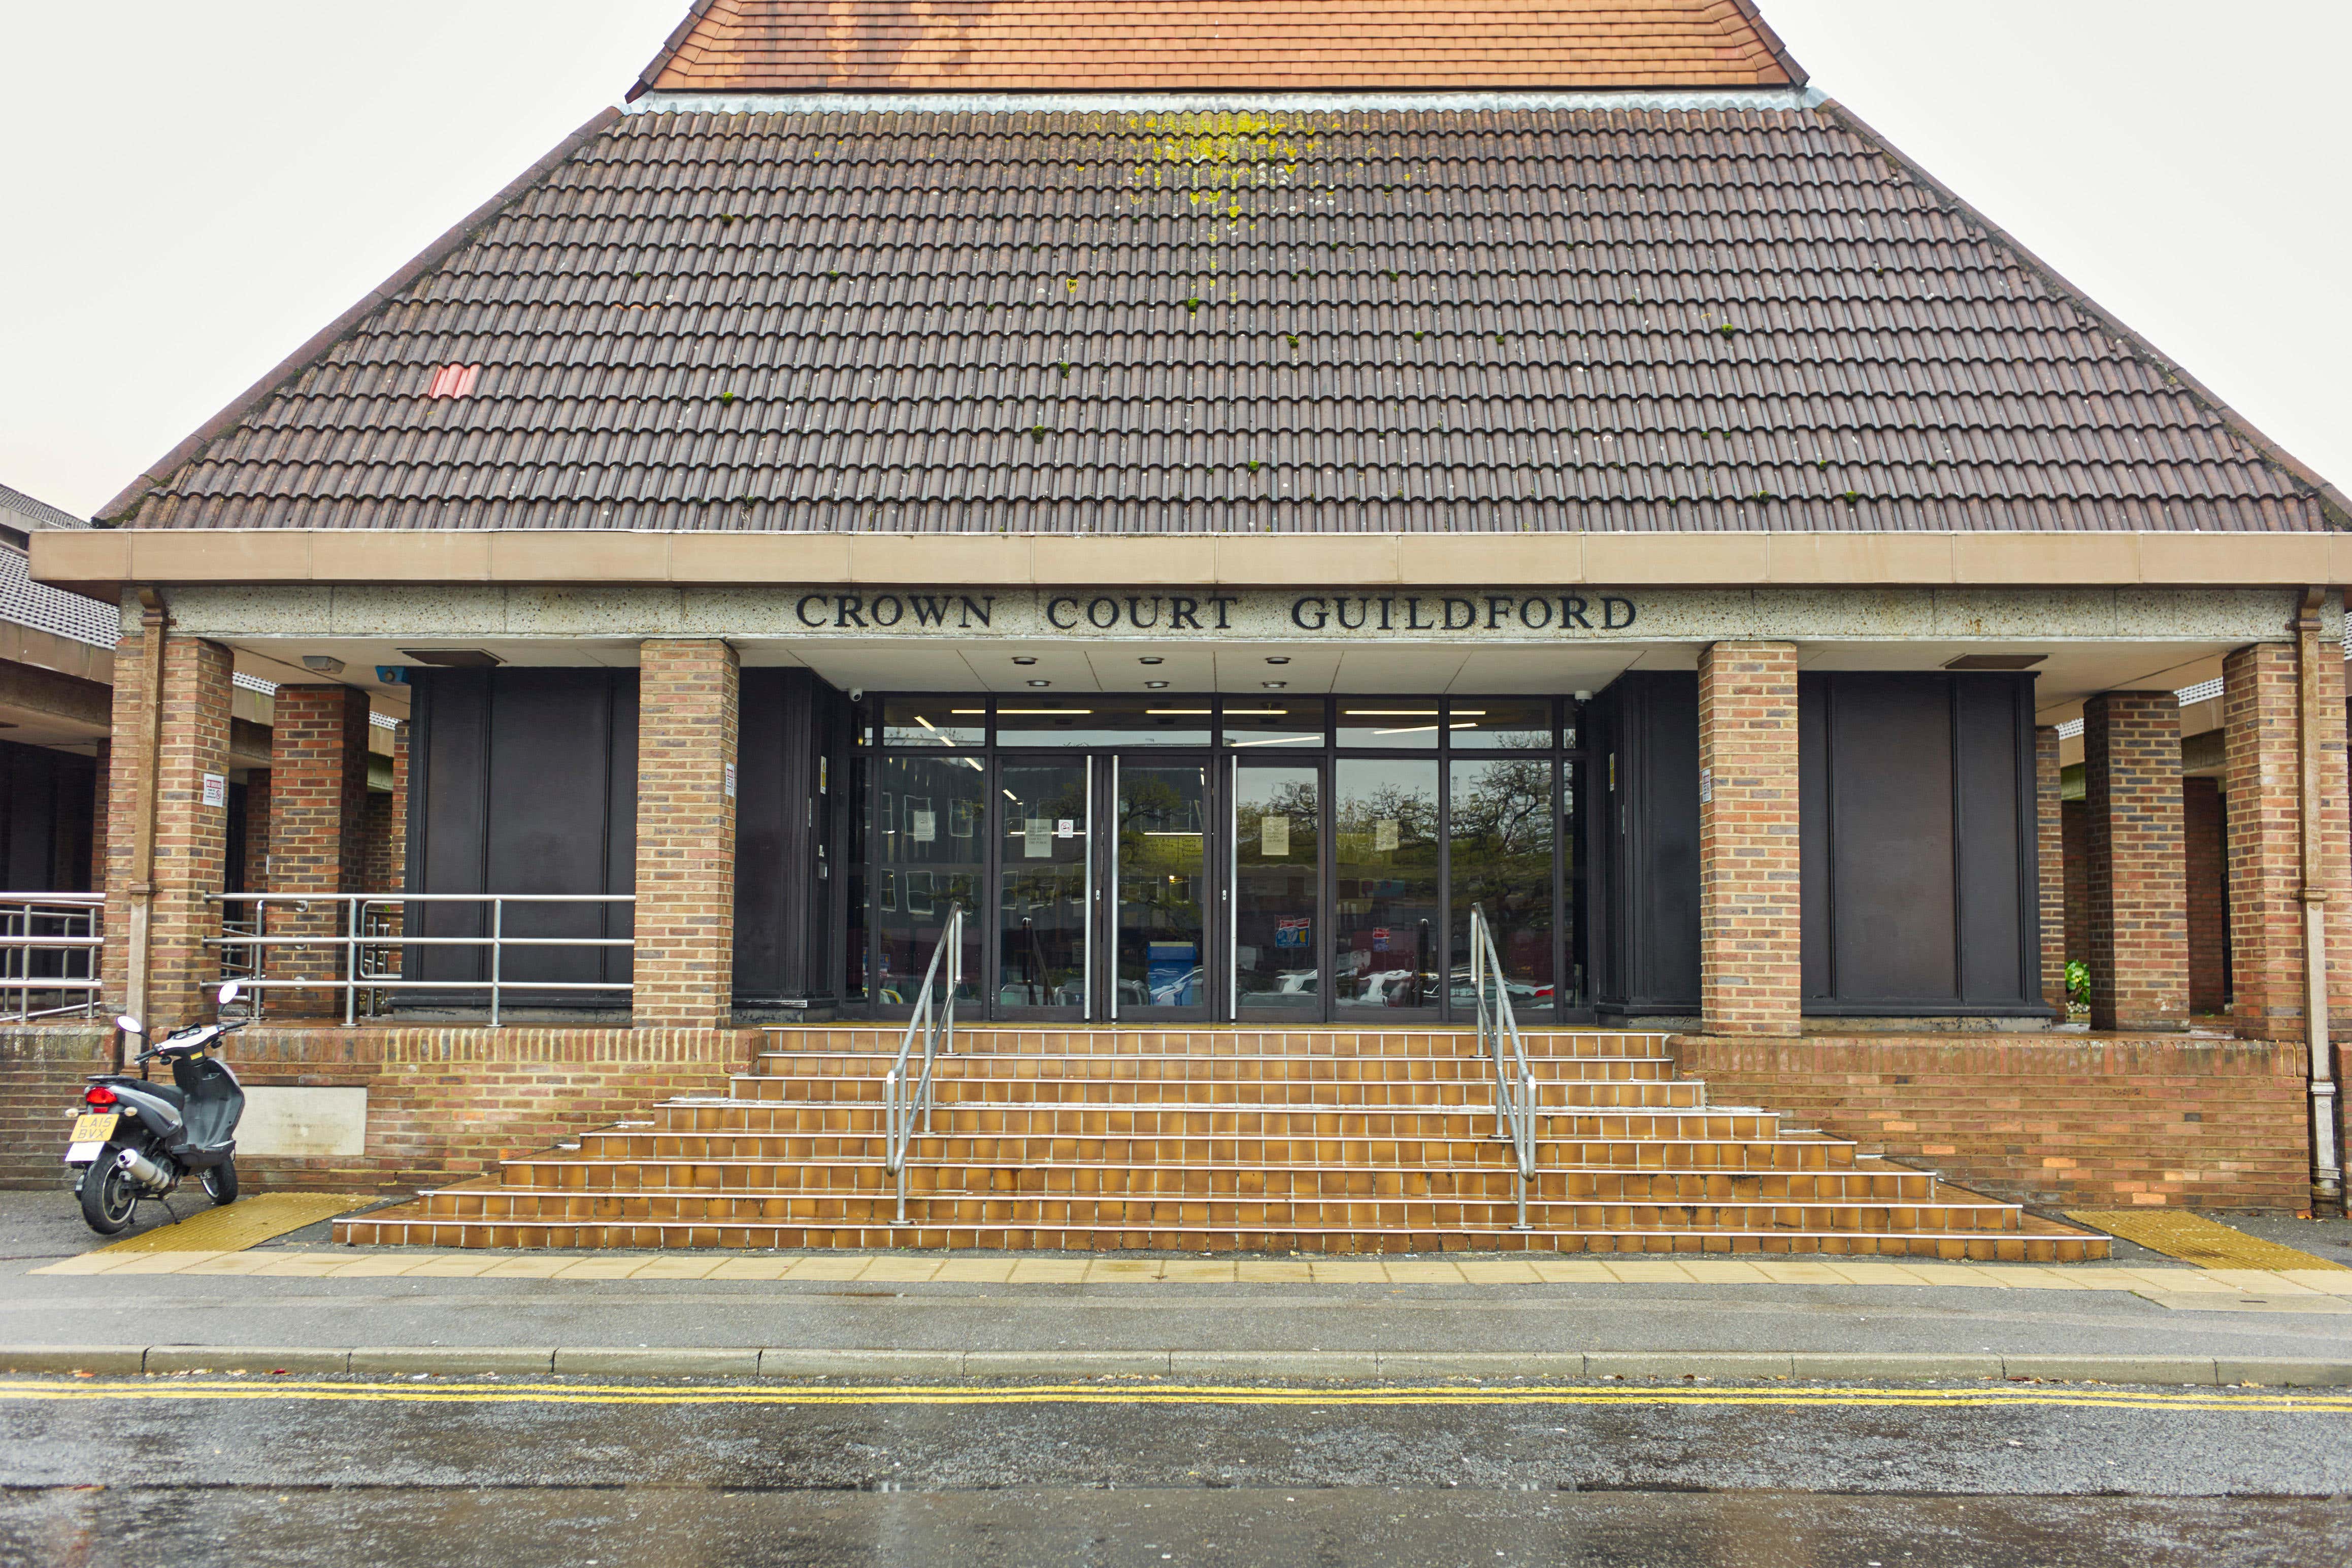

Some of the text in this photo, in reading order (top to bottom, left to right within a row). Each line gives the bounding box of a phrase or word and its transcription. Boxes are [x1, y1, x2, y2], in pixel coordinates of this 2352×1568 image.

[796, 595, 1636, 630] CROWN COURT GUILDFORD
[80, 1117, 113, 1127] LA15
[78, 1128, 107, 1139] BVX
